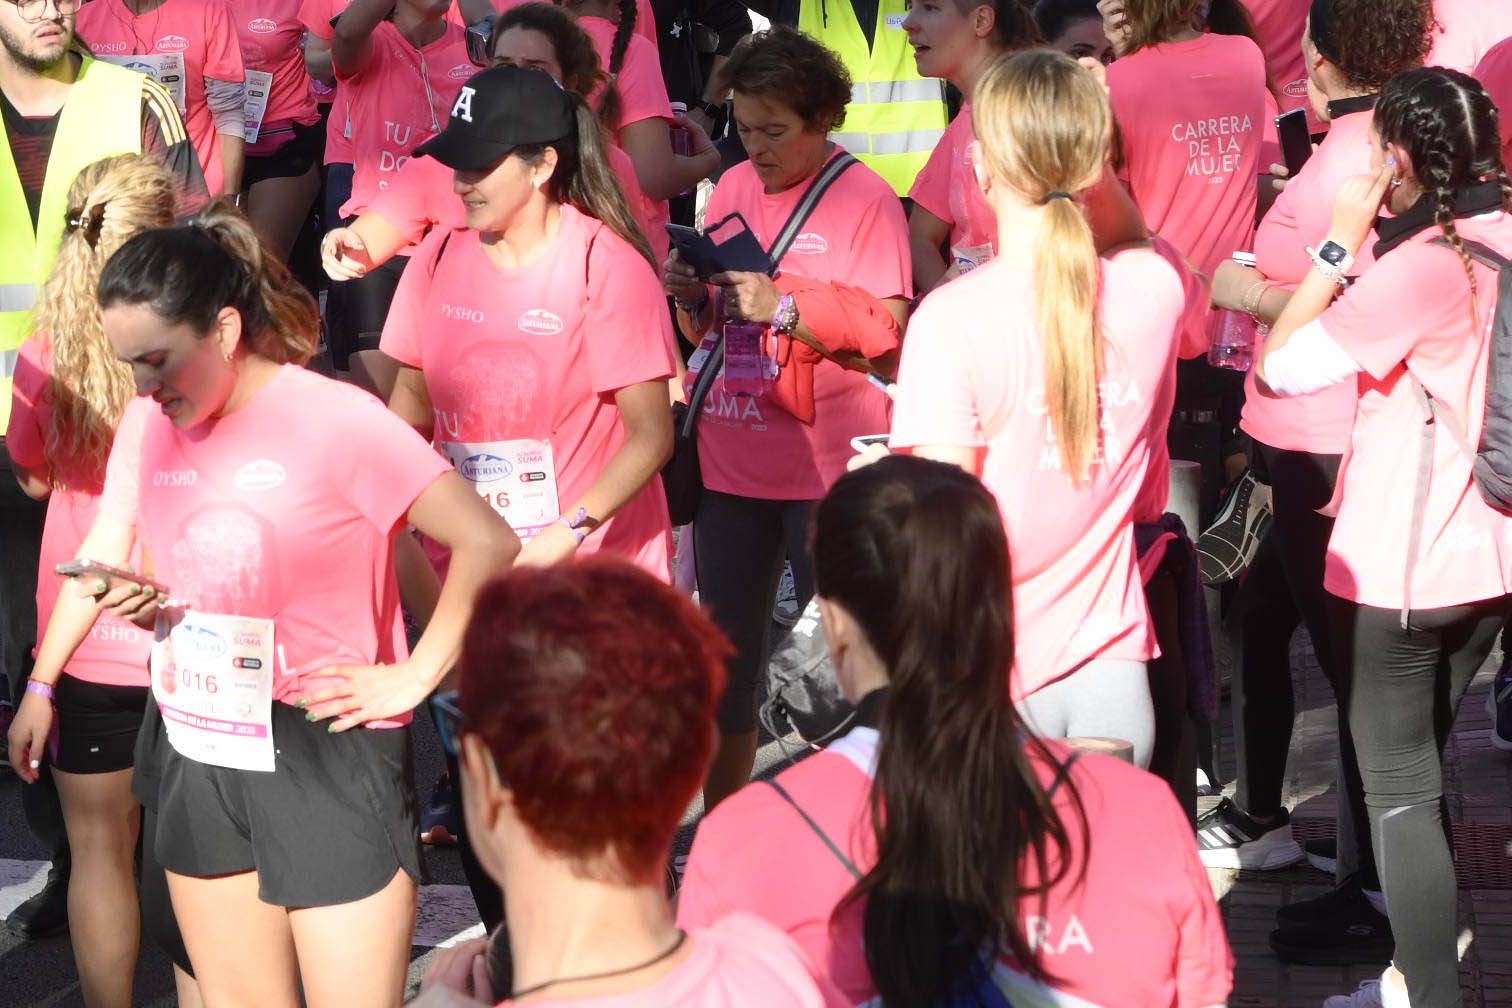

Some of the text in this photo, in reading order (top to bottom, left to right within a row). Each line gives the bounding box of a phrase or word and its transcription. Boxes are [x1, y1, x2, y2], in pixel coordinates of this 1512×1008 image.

[451, 86, 476, 123] A
[384, 120, 411, 145] TU
[1171, 114, 1252, 143] CARRERA
[1189, 138, 1241, 158] DE LA
[463, 461, 509, 475] ASTURIANA
[182, 668, 218, 694] 016
